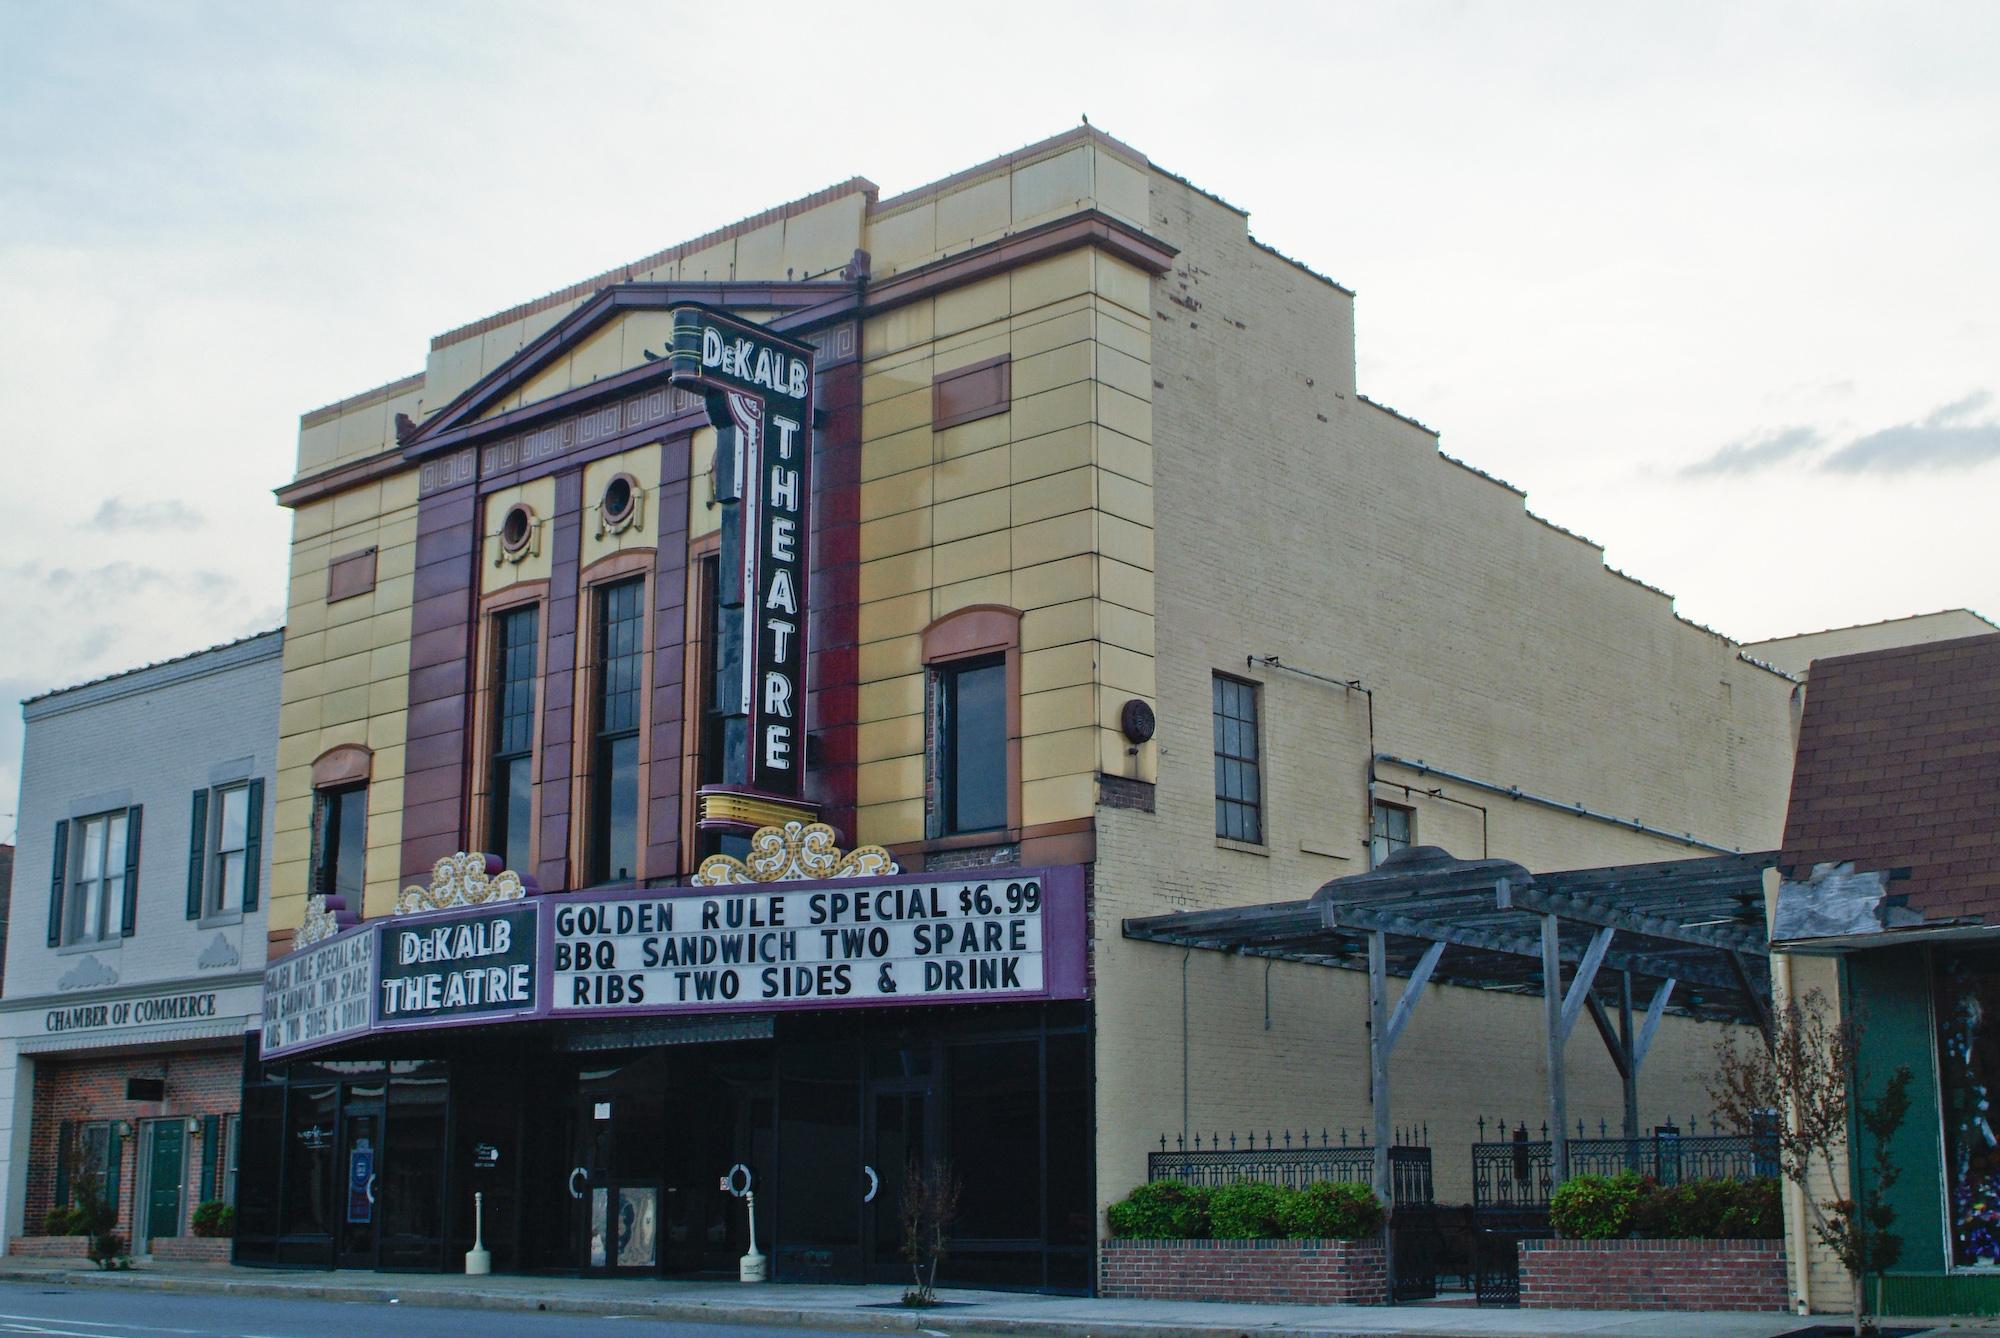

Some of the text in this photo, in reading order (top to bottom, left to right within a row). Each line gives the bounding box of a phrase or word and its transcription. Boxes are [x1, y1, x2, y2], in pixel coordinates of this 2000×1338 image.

[765, 414, 800, 770] THEATRE
[556, 881, 1041, 936] GOLDEN RULE SPECIAL $6.99
[295, 956, 313, 984] RULE
[316, 942, 349, 979] SPECIAL
[555, 919, 1027, 971] BBQ SANDWICH TWO SPARE
[321, 977, 337, 1004] TWO
[341, 965, 368, 999] SPARE
[382, 964, 529, 1014] THEATRE
[573, 956, 1021, 1005] RIBS TWO SIDES & DRINK
[46, 994, 216, 1031] CHAMBER OF COMMERCE
[306, 1009, 327, 1039] SIDES
